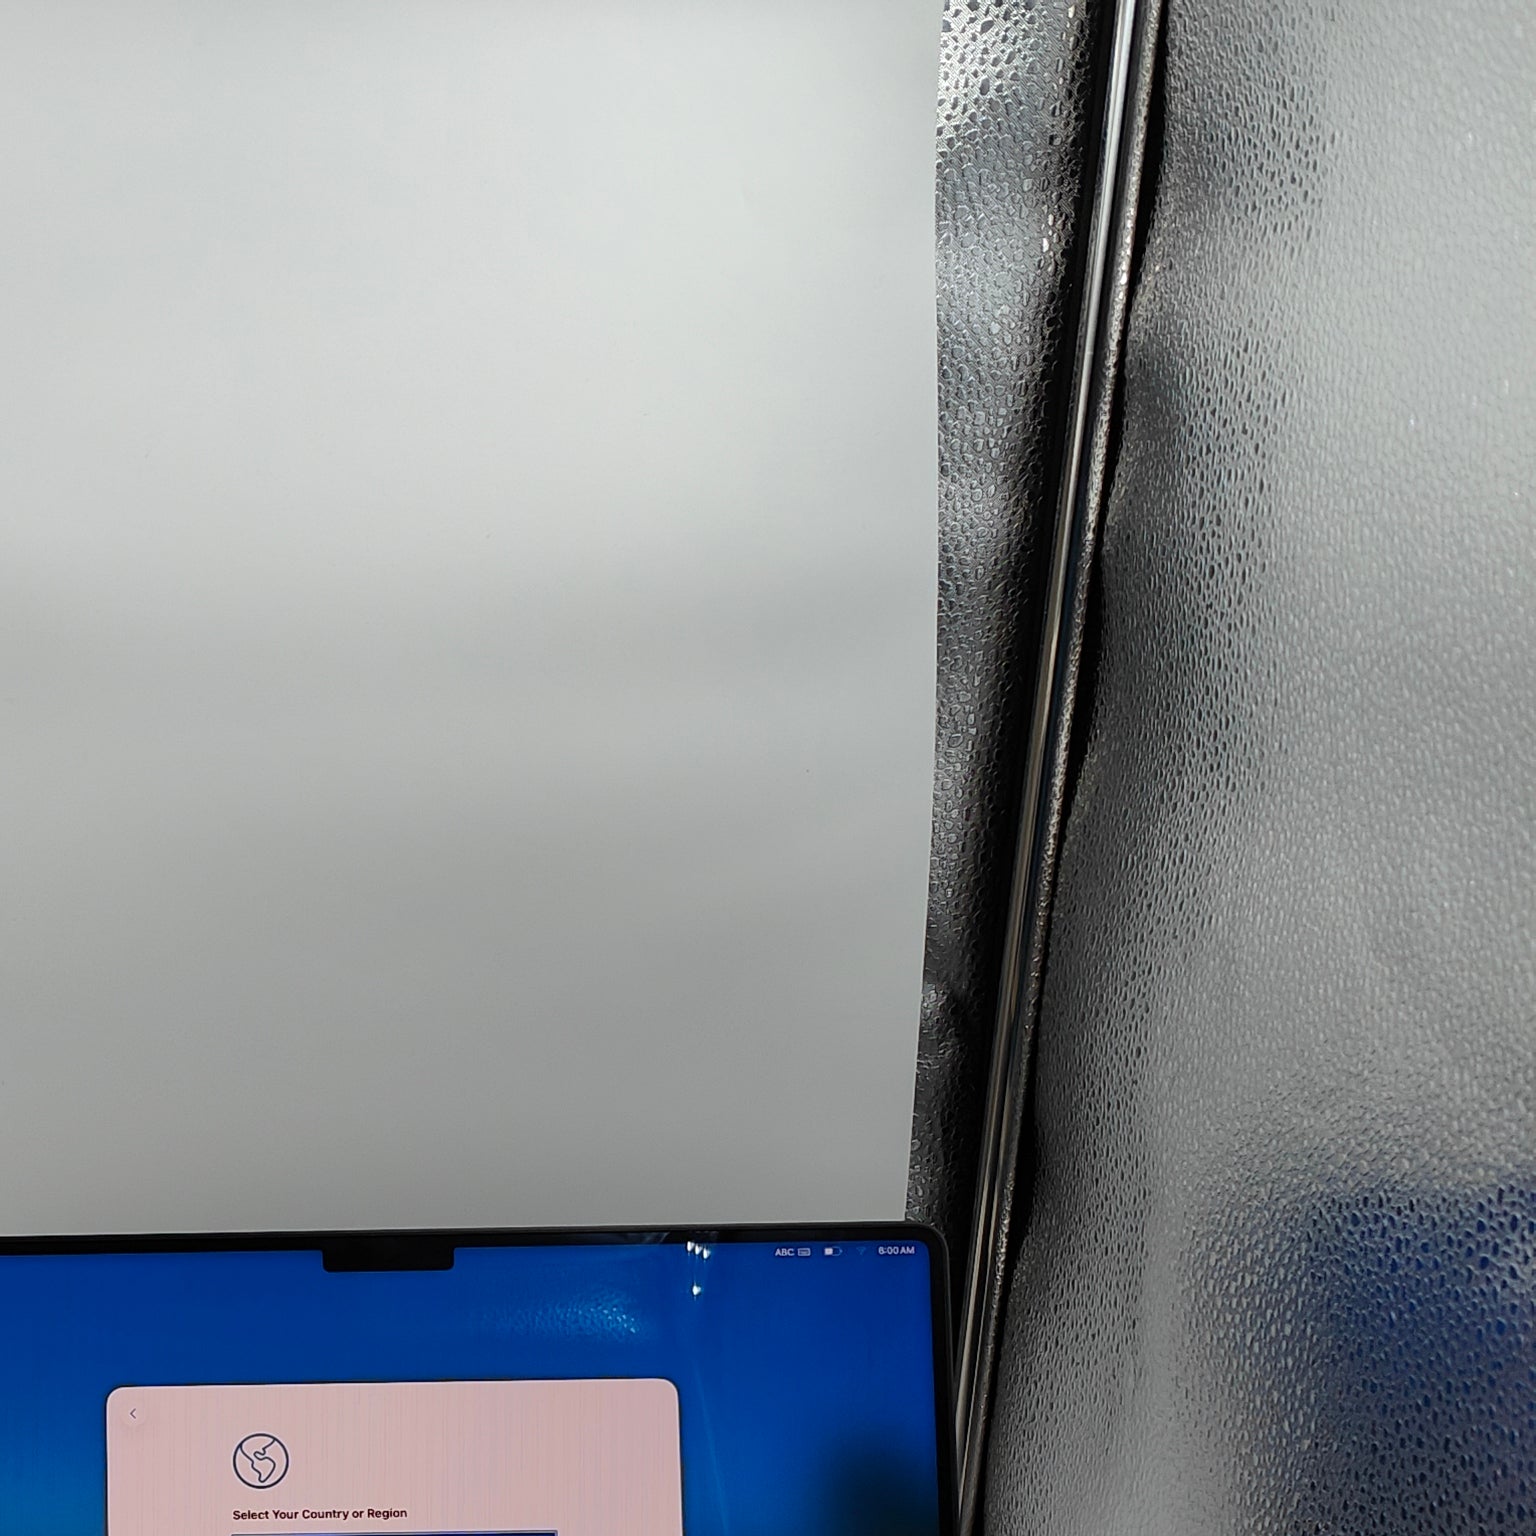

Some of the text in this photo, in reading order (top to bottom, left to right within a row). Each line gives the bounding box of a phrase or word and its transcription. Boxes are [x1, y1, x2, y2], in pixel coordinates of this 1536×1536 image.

[775, 1247, 795, 1256] ABC
[899, 1246, 915, 1254] AM
[232, 1508, 408, 1521] Select Your Country or Region
